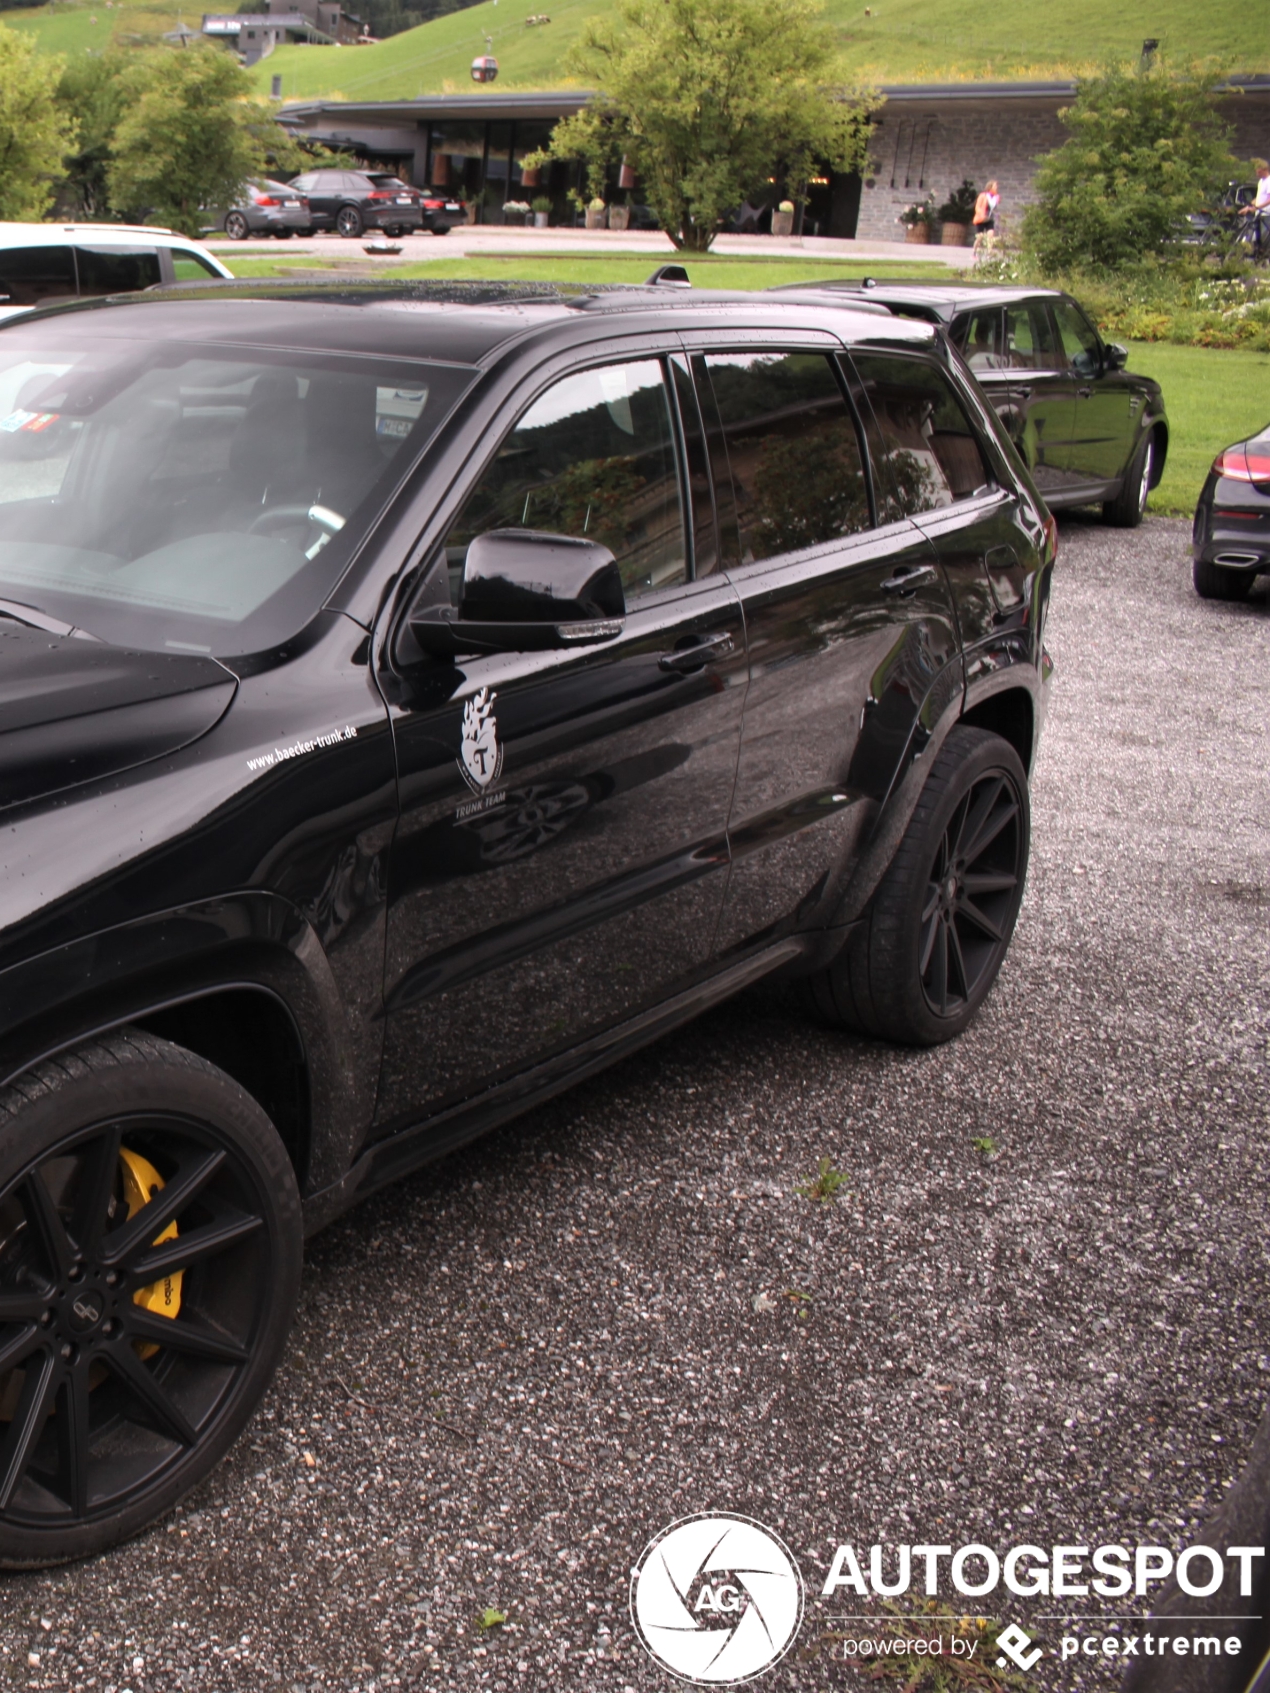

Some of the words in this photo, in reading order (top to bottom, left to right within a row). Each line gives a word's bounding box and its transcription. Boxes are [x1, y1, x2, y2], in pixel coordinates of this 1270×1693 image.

[247, 725, 358, 771] www.baecker-trunk.de
[473, 745, 489, 776] T
[455, 799, 483, 820] TRUNK
[485, 791, 507, 808] TEAM
